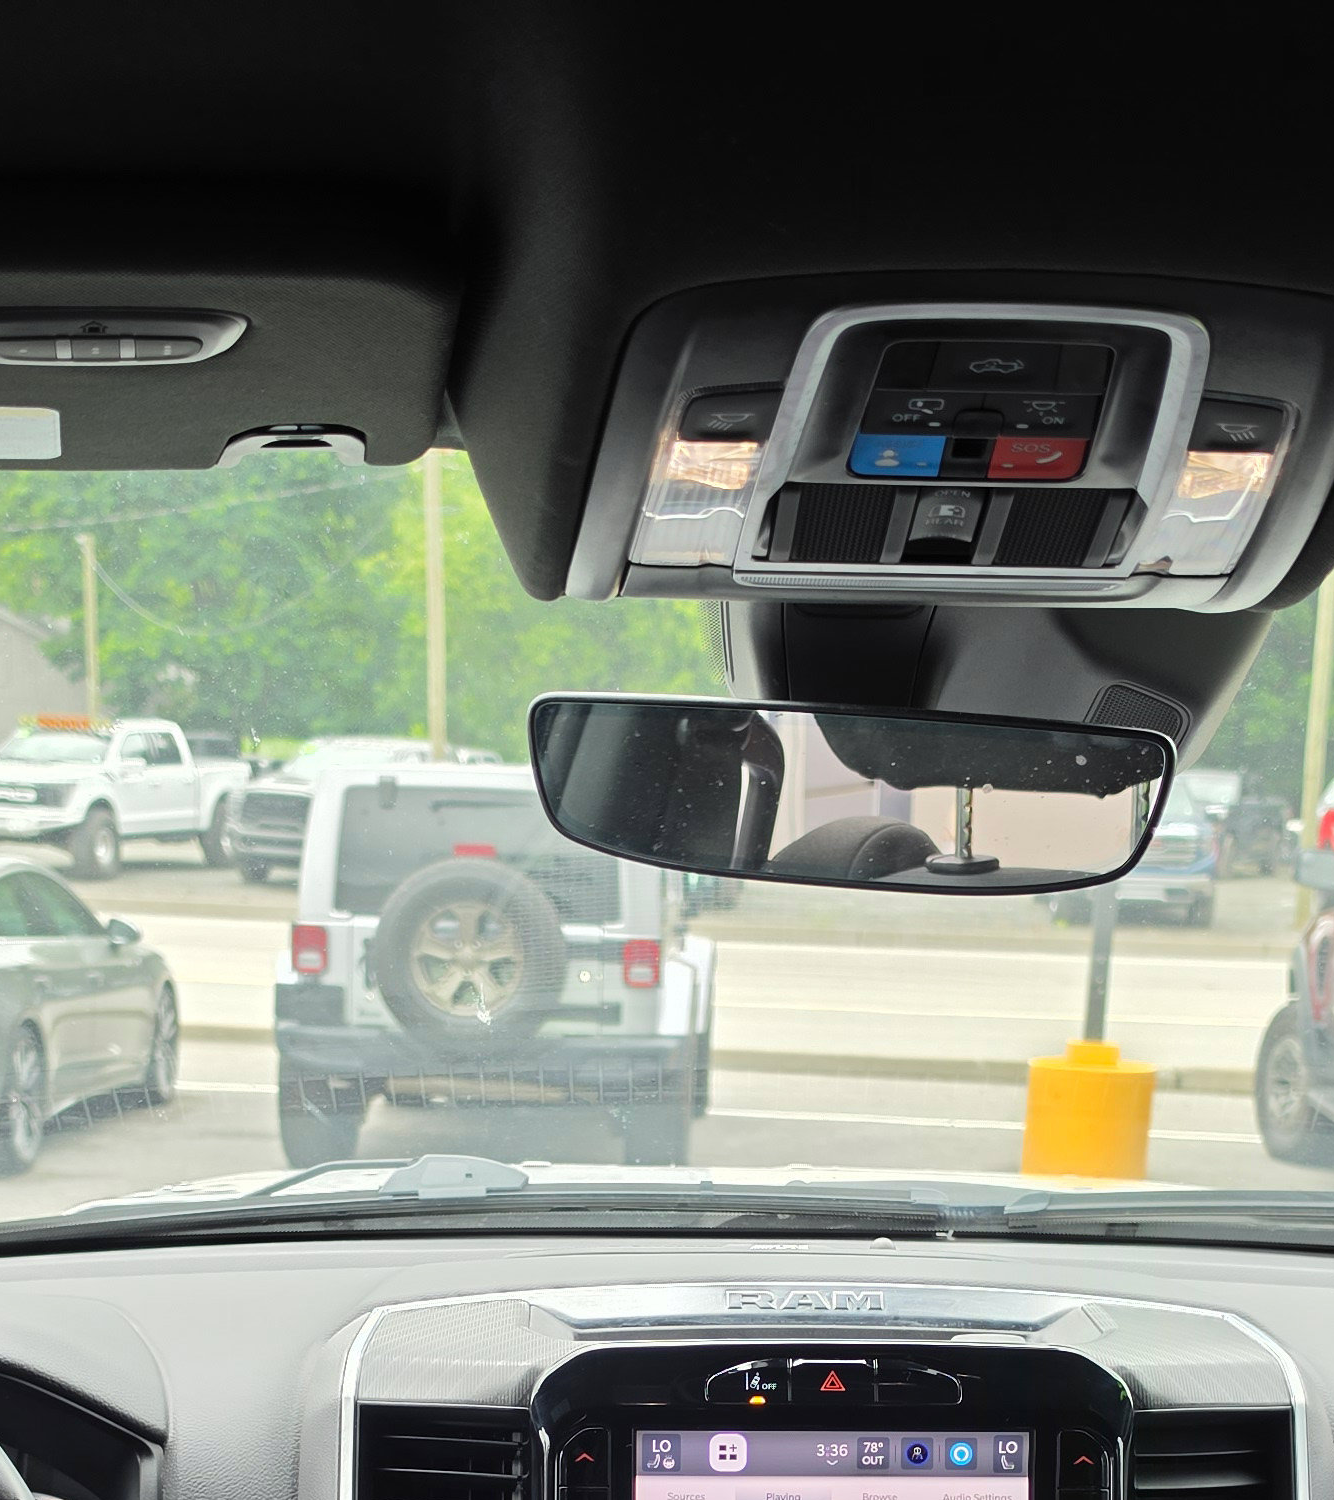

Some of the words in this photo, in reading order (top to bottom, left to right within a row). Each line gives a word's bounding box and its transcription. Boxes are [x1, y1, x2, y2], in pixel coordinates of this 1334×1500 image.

[892, 413, 921, 422] OFF
[1041, 416, 1064, 425] ON
[1011, 443, 1050, 453] SOS
[725, 1288, 888, 1311] RAM
[761, 1382, 777, 1390] OFF
[651, 1439, 672, 1453] LO
[815, 1443, 849, 1458] 3:36
[997, 1440, 1018, 1455] LO
[861, 1455, 885, 1466] OUT
